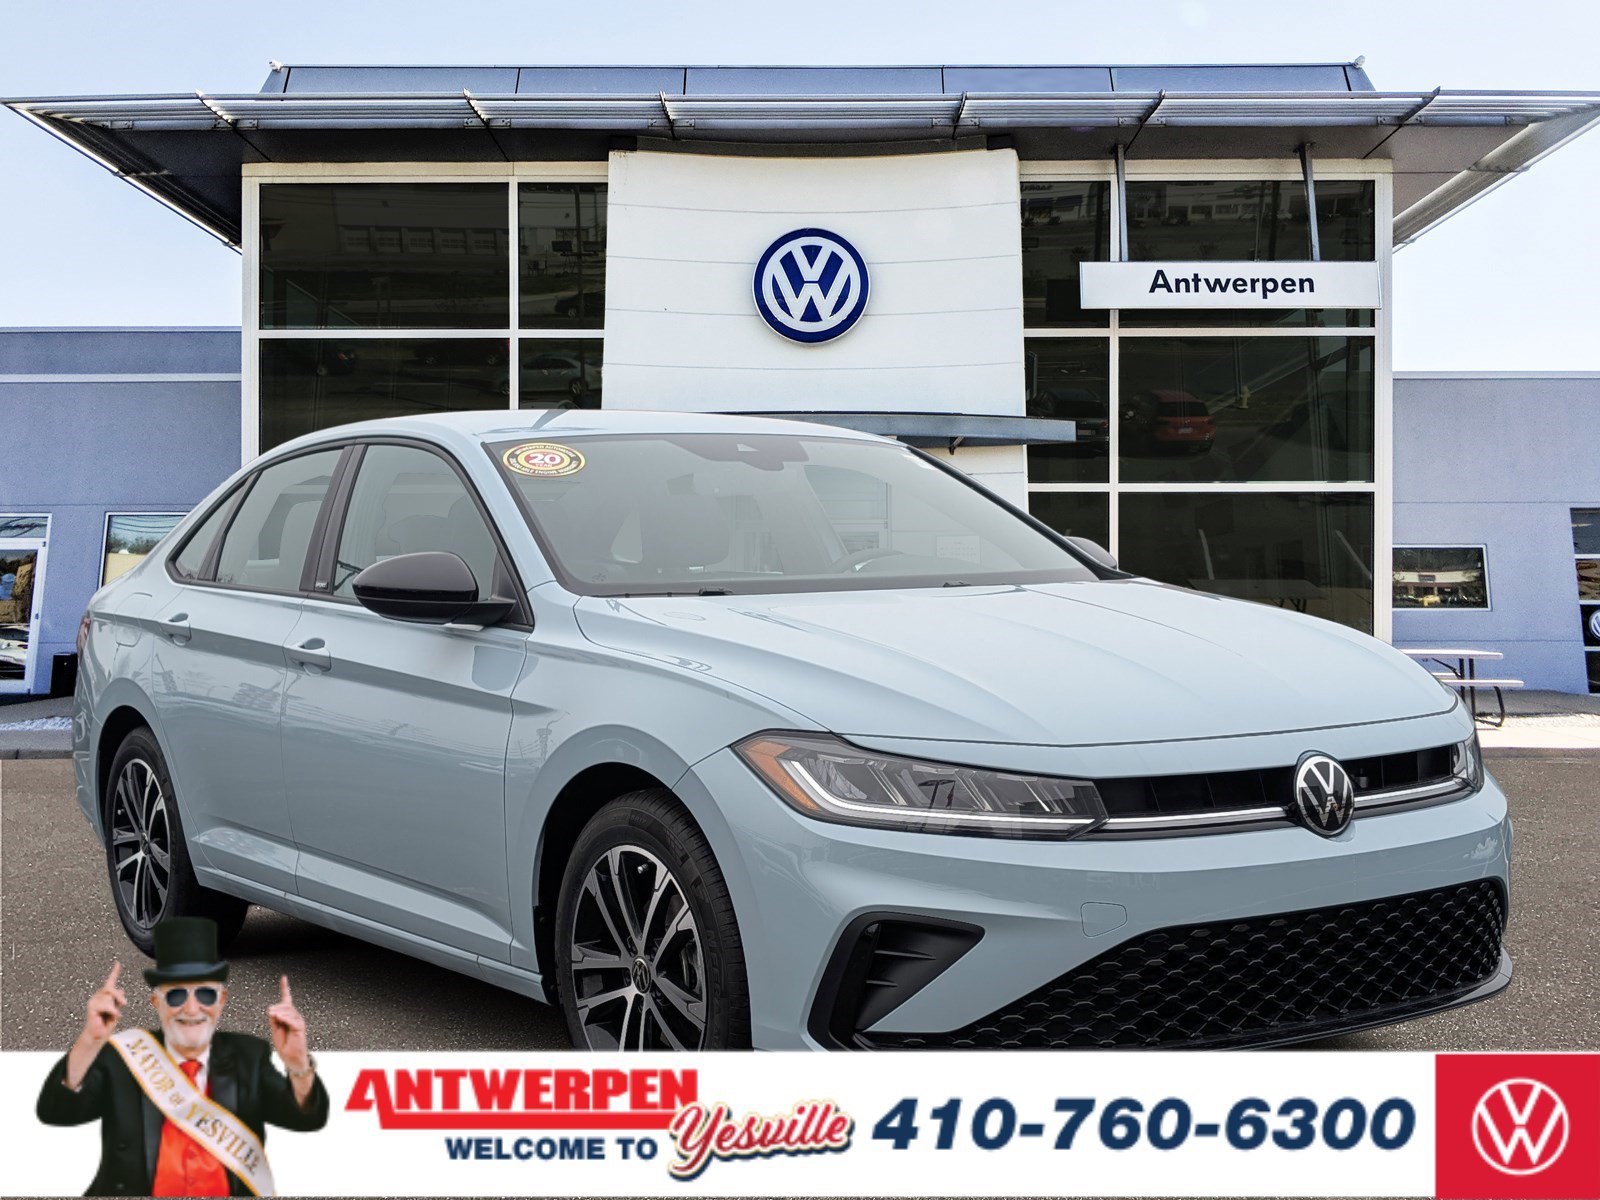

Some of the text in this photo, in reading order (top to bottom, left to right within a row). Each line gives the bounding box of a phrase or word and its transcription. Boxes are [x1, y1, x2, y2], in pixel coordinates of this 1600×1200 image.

[761, 234, 862, 334] VW
[1148, 269, 1315, 299] Antwerpen
[528, 452, 562, 465] 20
